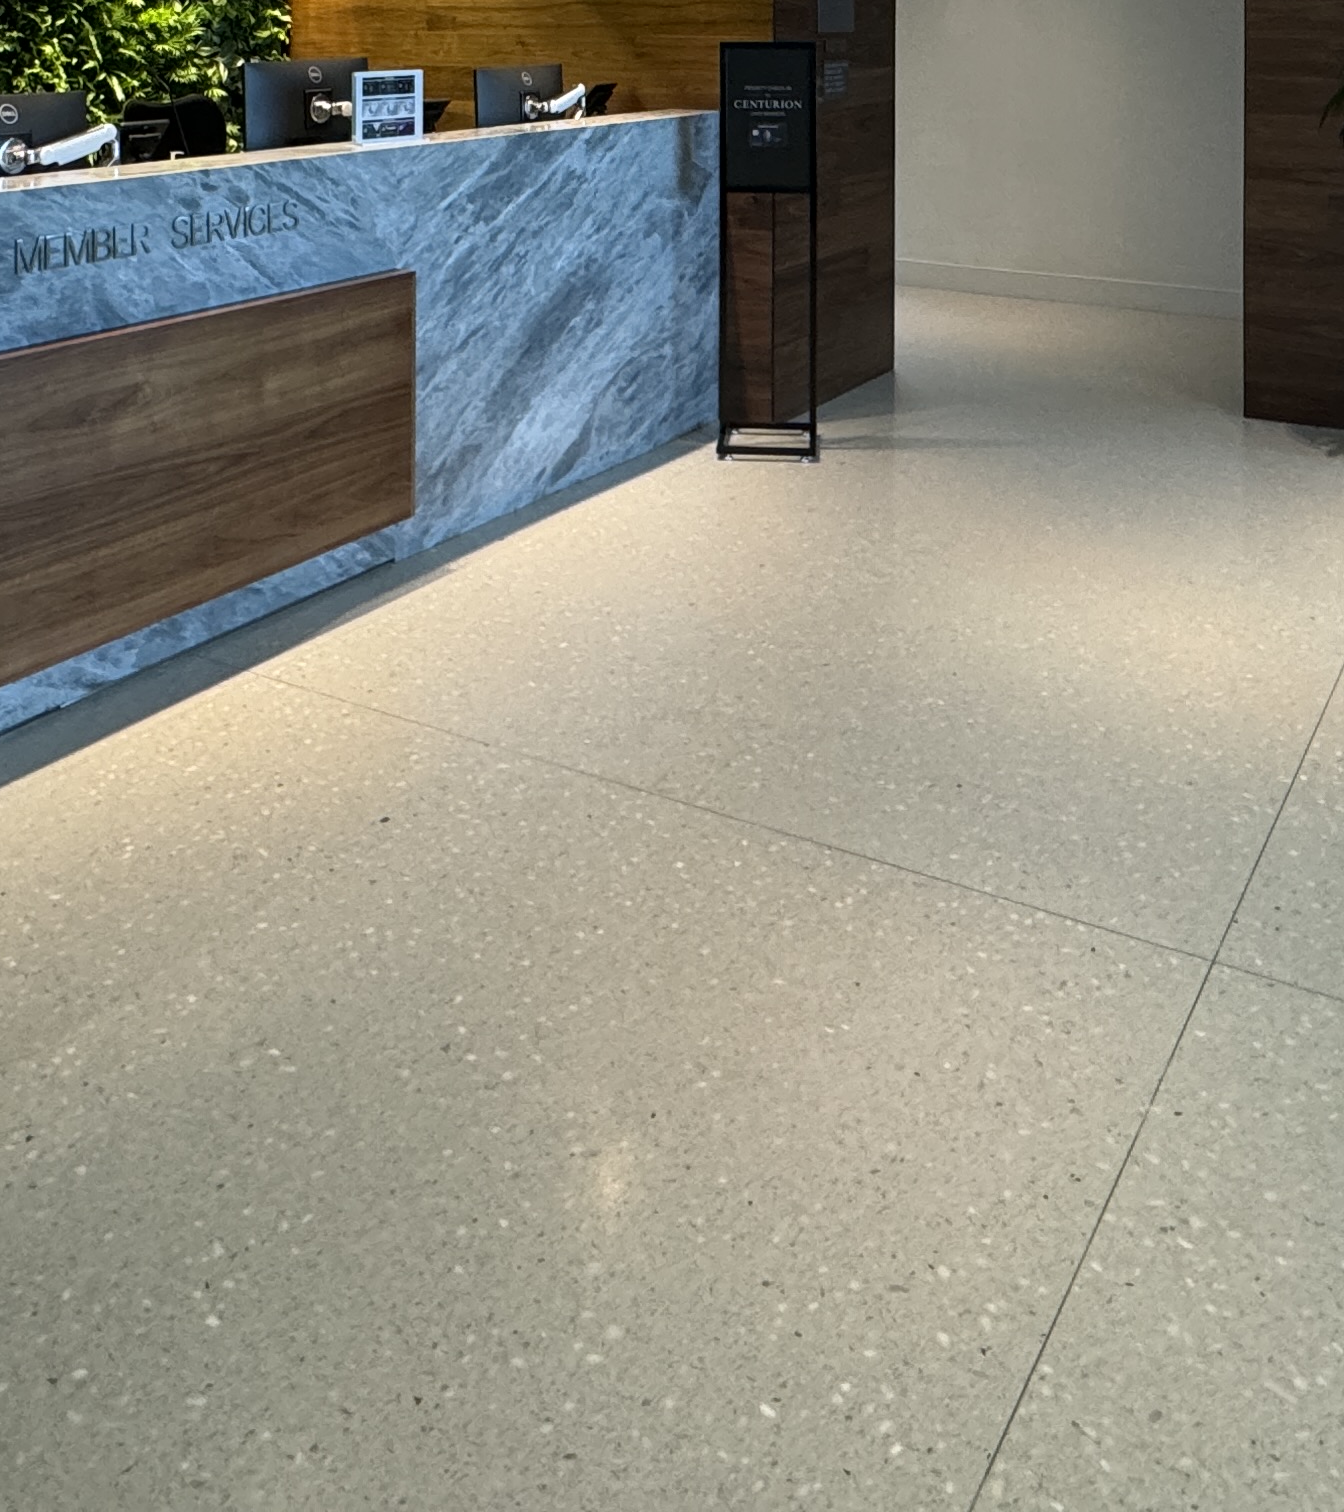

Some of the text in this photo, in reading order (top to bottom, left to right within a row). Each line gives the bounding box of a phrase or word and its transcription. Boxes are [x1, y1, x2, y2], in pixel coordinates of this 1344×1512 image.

[733, 99, 803, 109] CENTURION
[14, 199, 300, 275] MEMBER SERVICES
